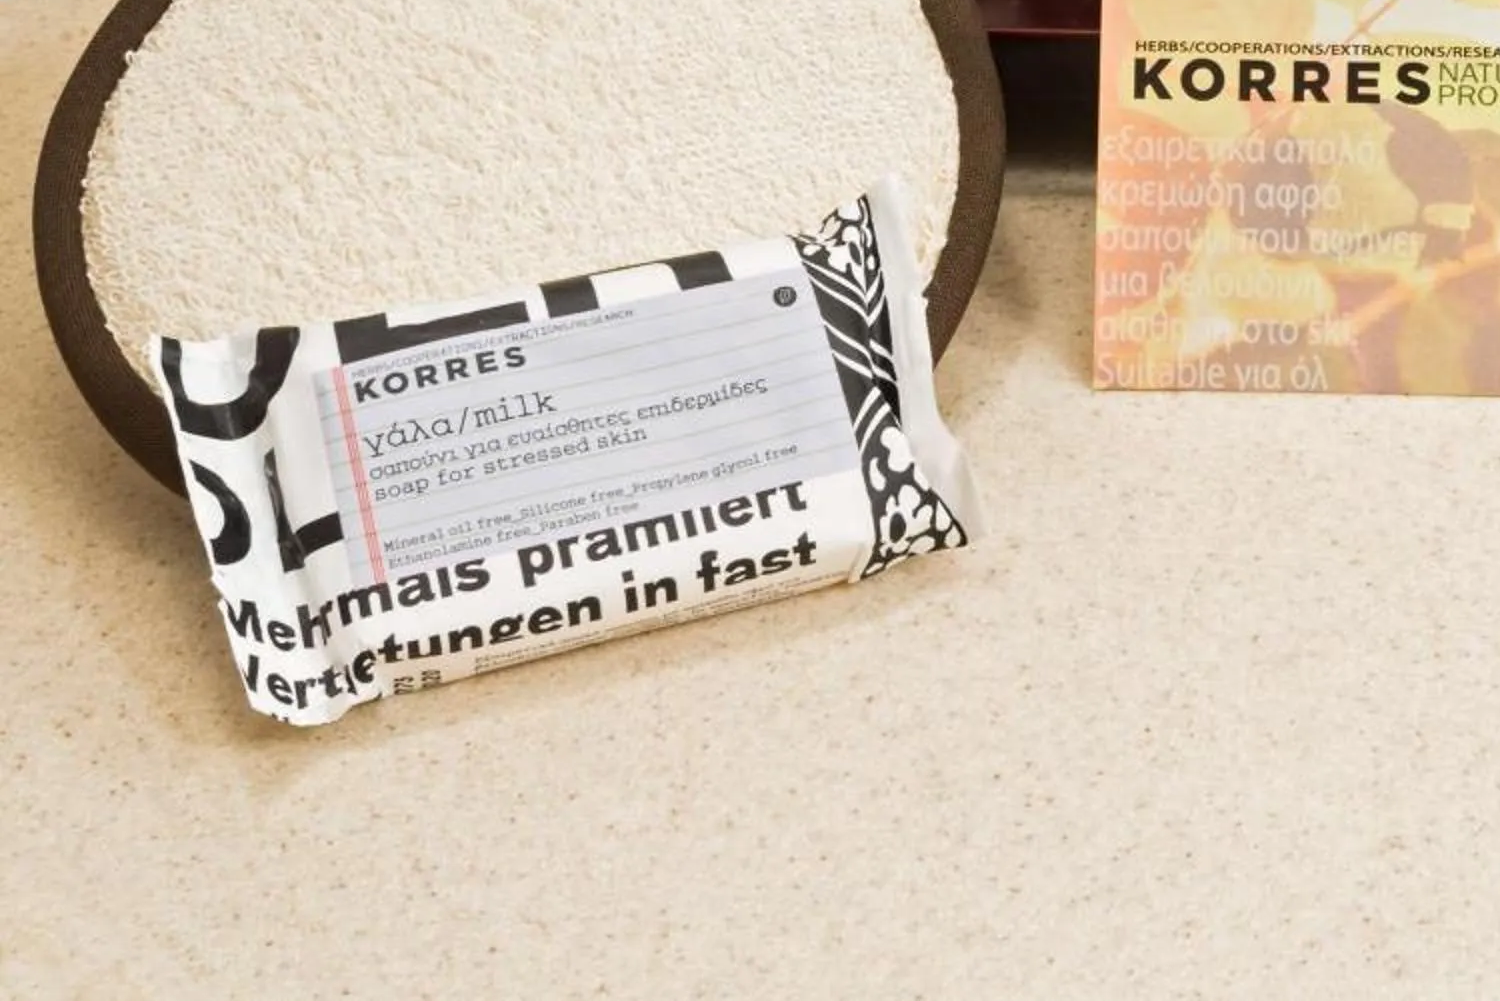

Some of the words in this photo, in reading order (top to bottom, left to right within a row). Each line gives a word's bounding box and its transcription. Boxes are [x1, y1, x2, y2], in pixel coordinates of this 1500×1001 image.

[1133, 57, 1431, 105] KORRES
[1100, 170, 1246, 216] κρεμώδη
[1238, 227, 1300, 254] που
[1242, 319, 1299, 345] στο
[353, 346, 527, 403] KORRES
[1096, 352, 1226, 389] Suitable
[1233, 363, 1281, 391] για
[363, 391, 557, 459] γάλα/milk
[370, 449, 459, 481] σαπούνι
[464, 437, 501, 460] για
[637, 377, 769, 421] επιδερμίδες
[375, 477, 429, 501] soap
[437, 465, 475, 486] for
[483, 437, 589, 475] stressed
[597, 428, 647, 450] skin
[384, 528, 444, 553] Mineral
[449, 521, 473, 535] oil
[712, 453, 761, 478] glycol
[764, 445, 798, 462] free
[388, 536, 493, 569] Ethanolamine
[606, 501, 639, 517] free
[622, 570, 678, 613] in
[697, 531, 817, 593] fast
